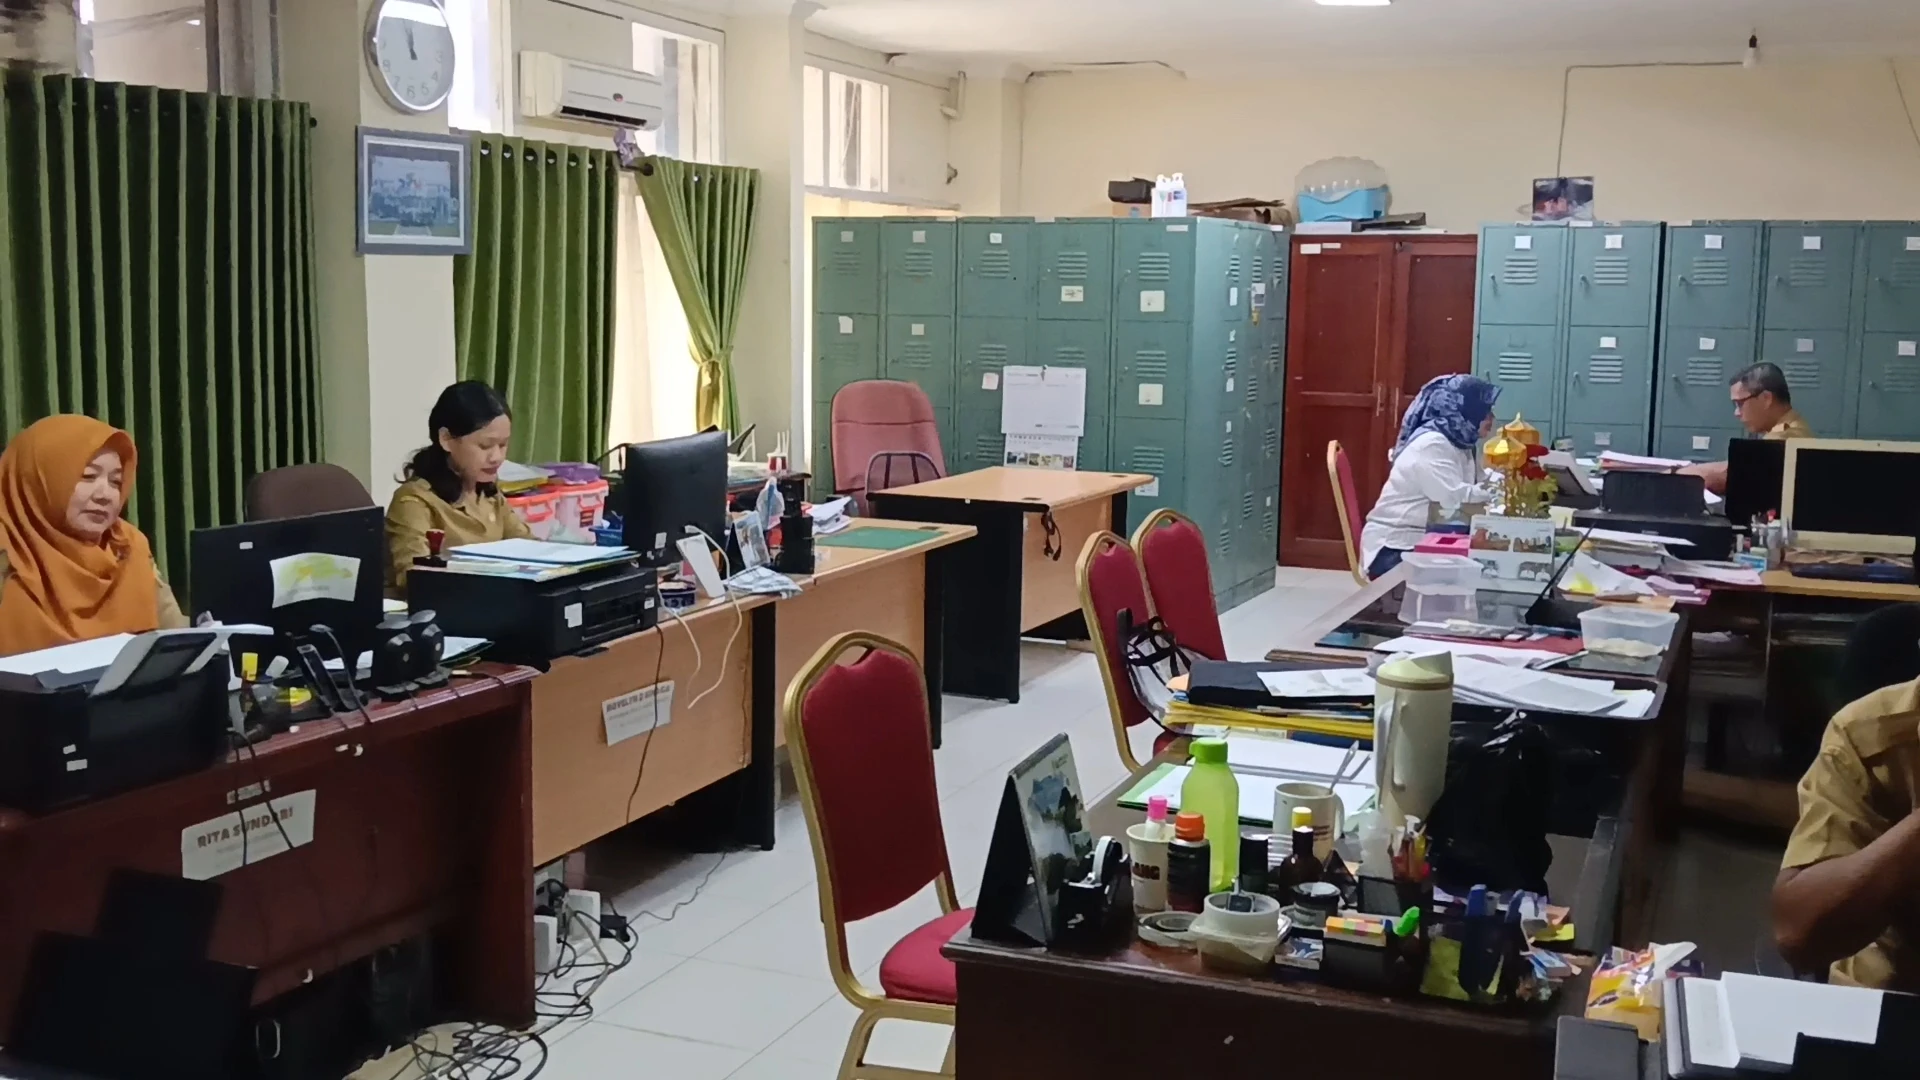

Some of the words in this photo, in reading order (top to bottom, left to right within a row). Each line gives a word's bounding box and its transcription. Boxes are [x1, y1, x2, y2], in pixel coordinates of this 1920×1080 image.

[394, 75, 401, 89] 7
[431, 71, 438, 81] 4
[406, 85, 416, 99] 6
[421, 82, 430, 96] 5
[197, 828, 230, 848] RITA
